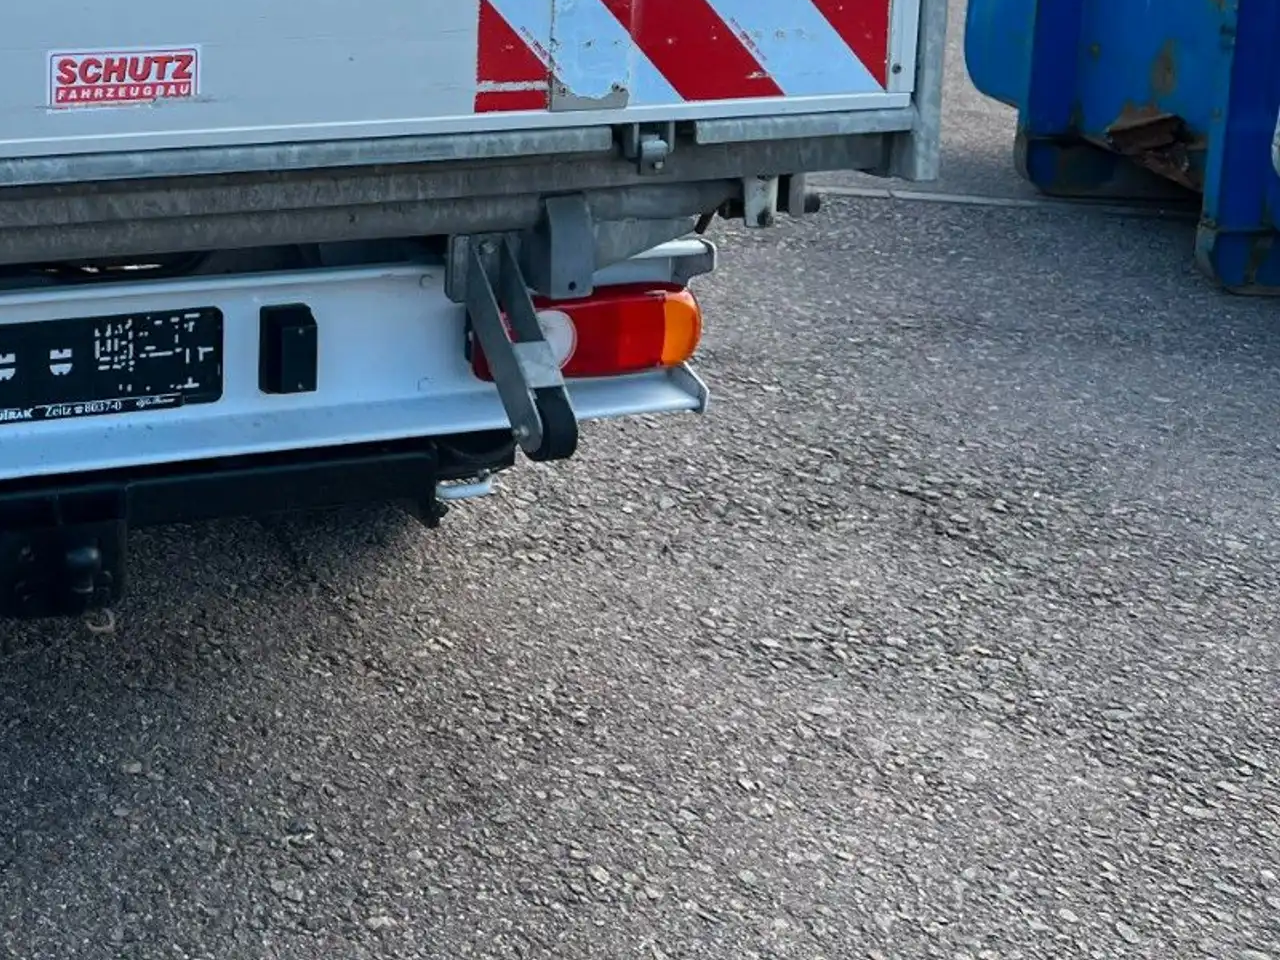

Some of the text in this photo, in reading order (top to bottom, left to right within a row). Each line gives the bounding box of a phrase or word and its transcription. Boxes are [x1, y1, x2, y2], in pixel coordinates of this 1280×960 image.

[56, 54, 194, 85] SCHUTZ
[57, 84, 191, 101] FAHRZEUGBAU
[44, 404, 72, 418] Zeitz
